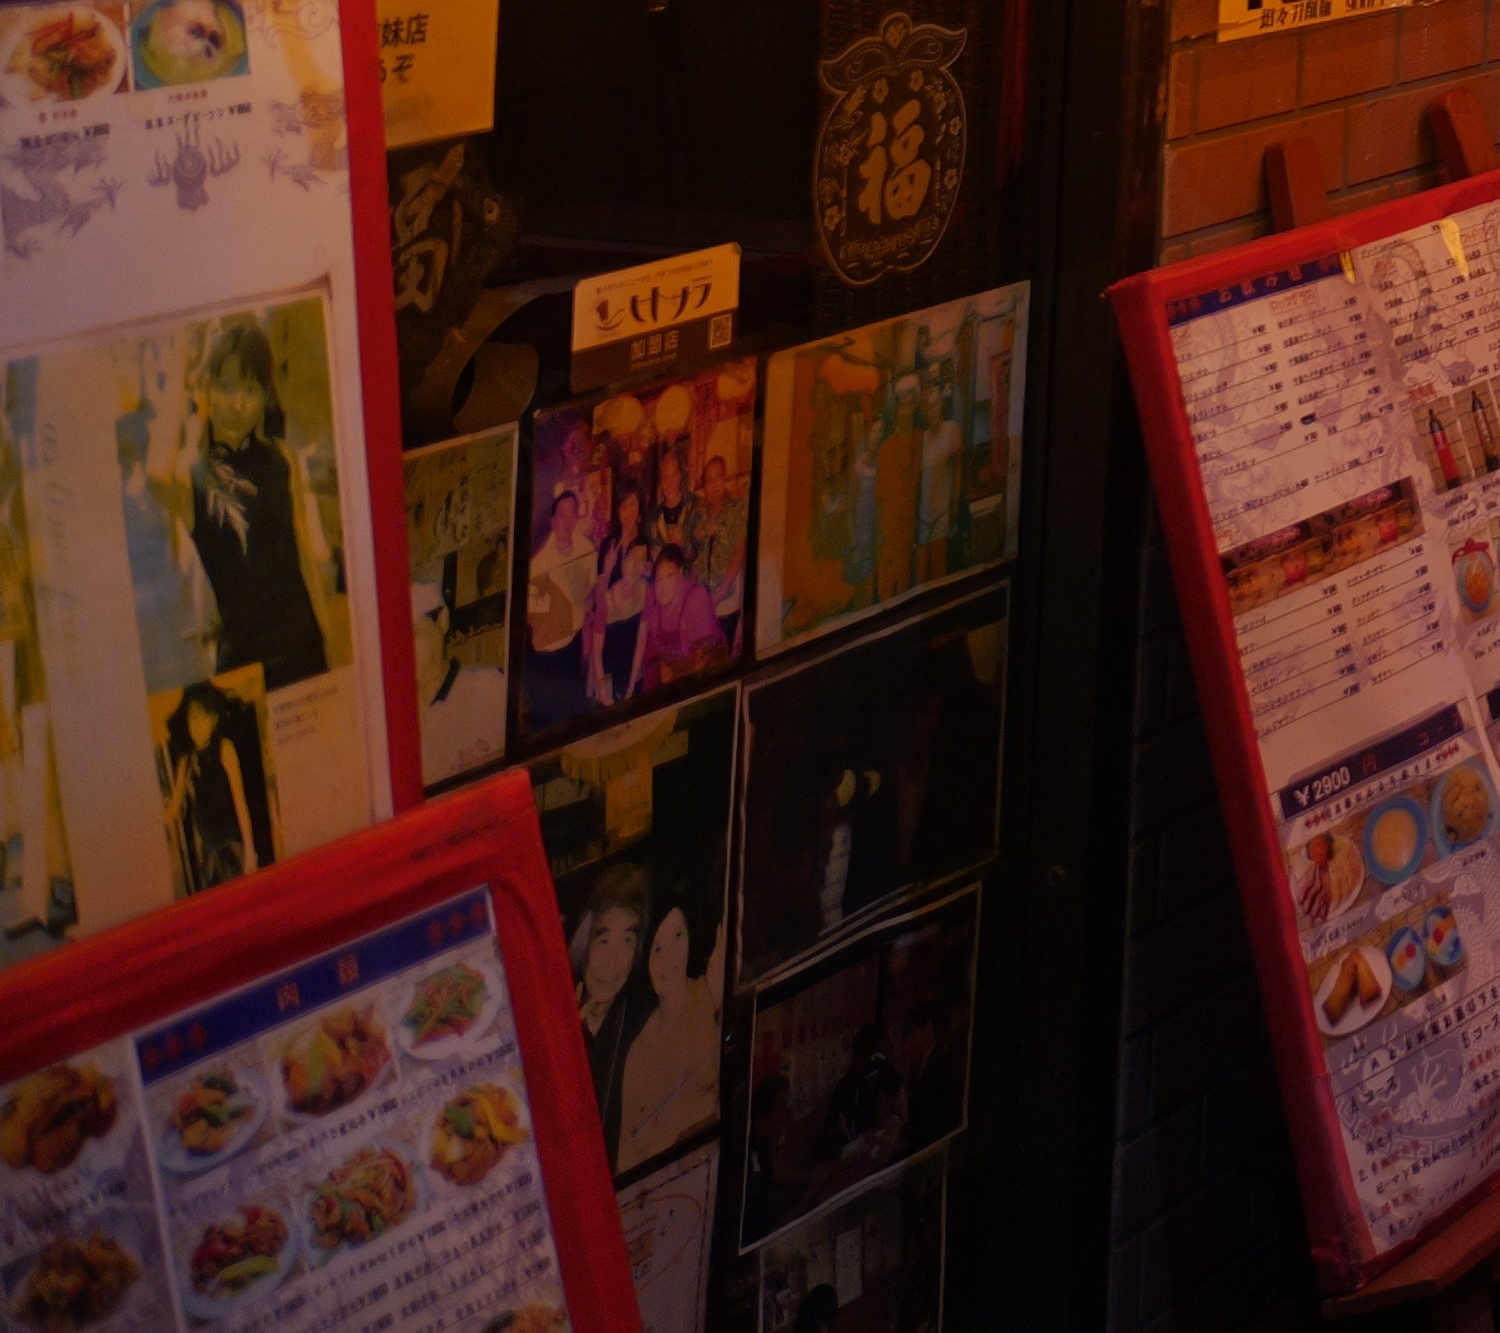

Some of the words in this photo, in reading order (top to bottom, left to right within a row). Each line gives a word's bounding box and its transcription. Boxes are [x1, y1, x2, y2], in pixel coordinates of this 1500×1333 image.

[377, 13, 429, 46] 妹店
[858, 99, 933, 225] 福
[1292, 765, 1351, 808] ¥2900
